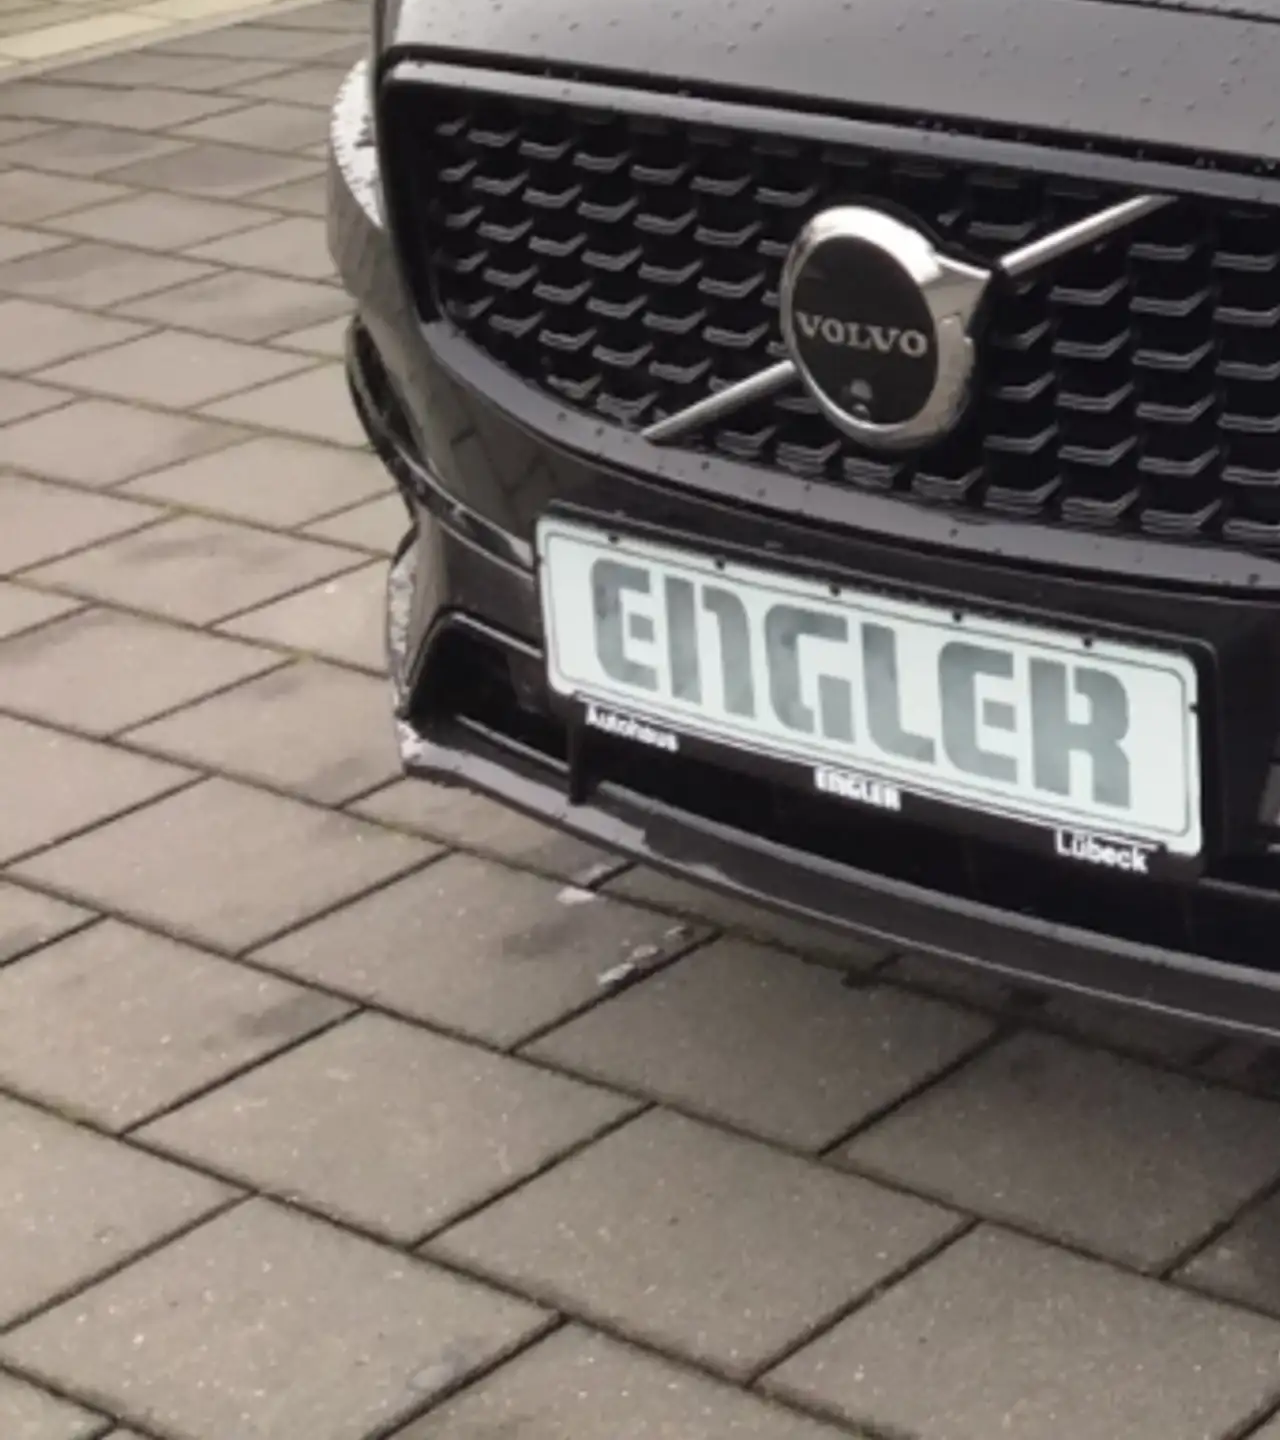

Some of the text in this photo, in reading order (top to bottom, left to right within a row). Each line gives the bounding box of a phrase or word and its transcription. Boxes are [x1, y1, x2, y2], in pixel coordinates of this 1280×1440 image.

[796, 312, 929, 358] VOLVO
[589, 558, 1132, 810] ENGLER
[586, 704, 680, 753] Autohaus
[1055, 827, 1149, 874] Lübeck
